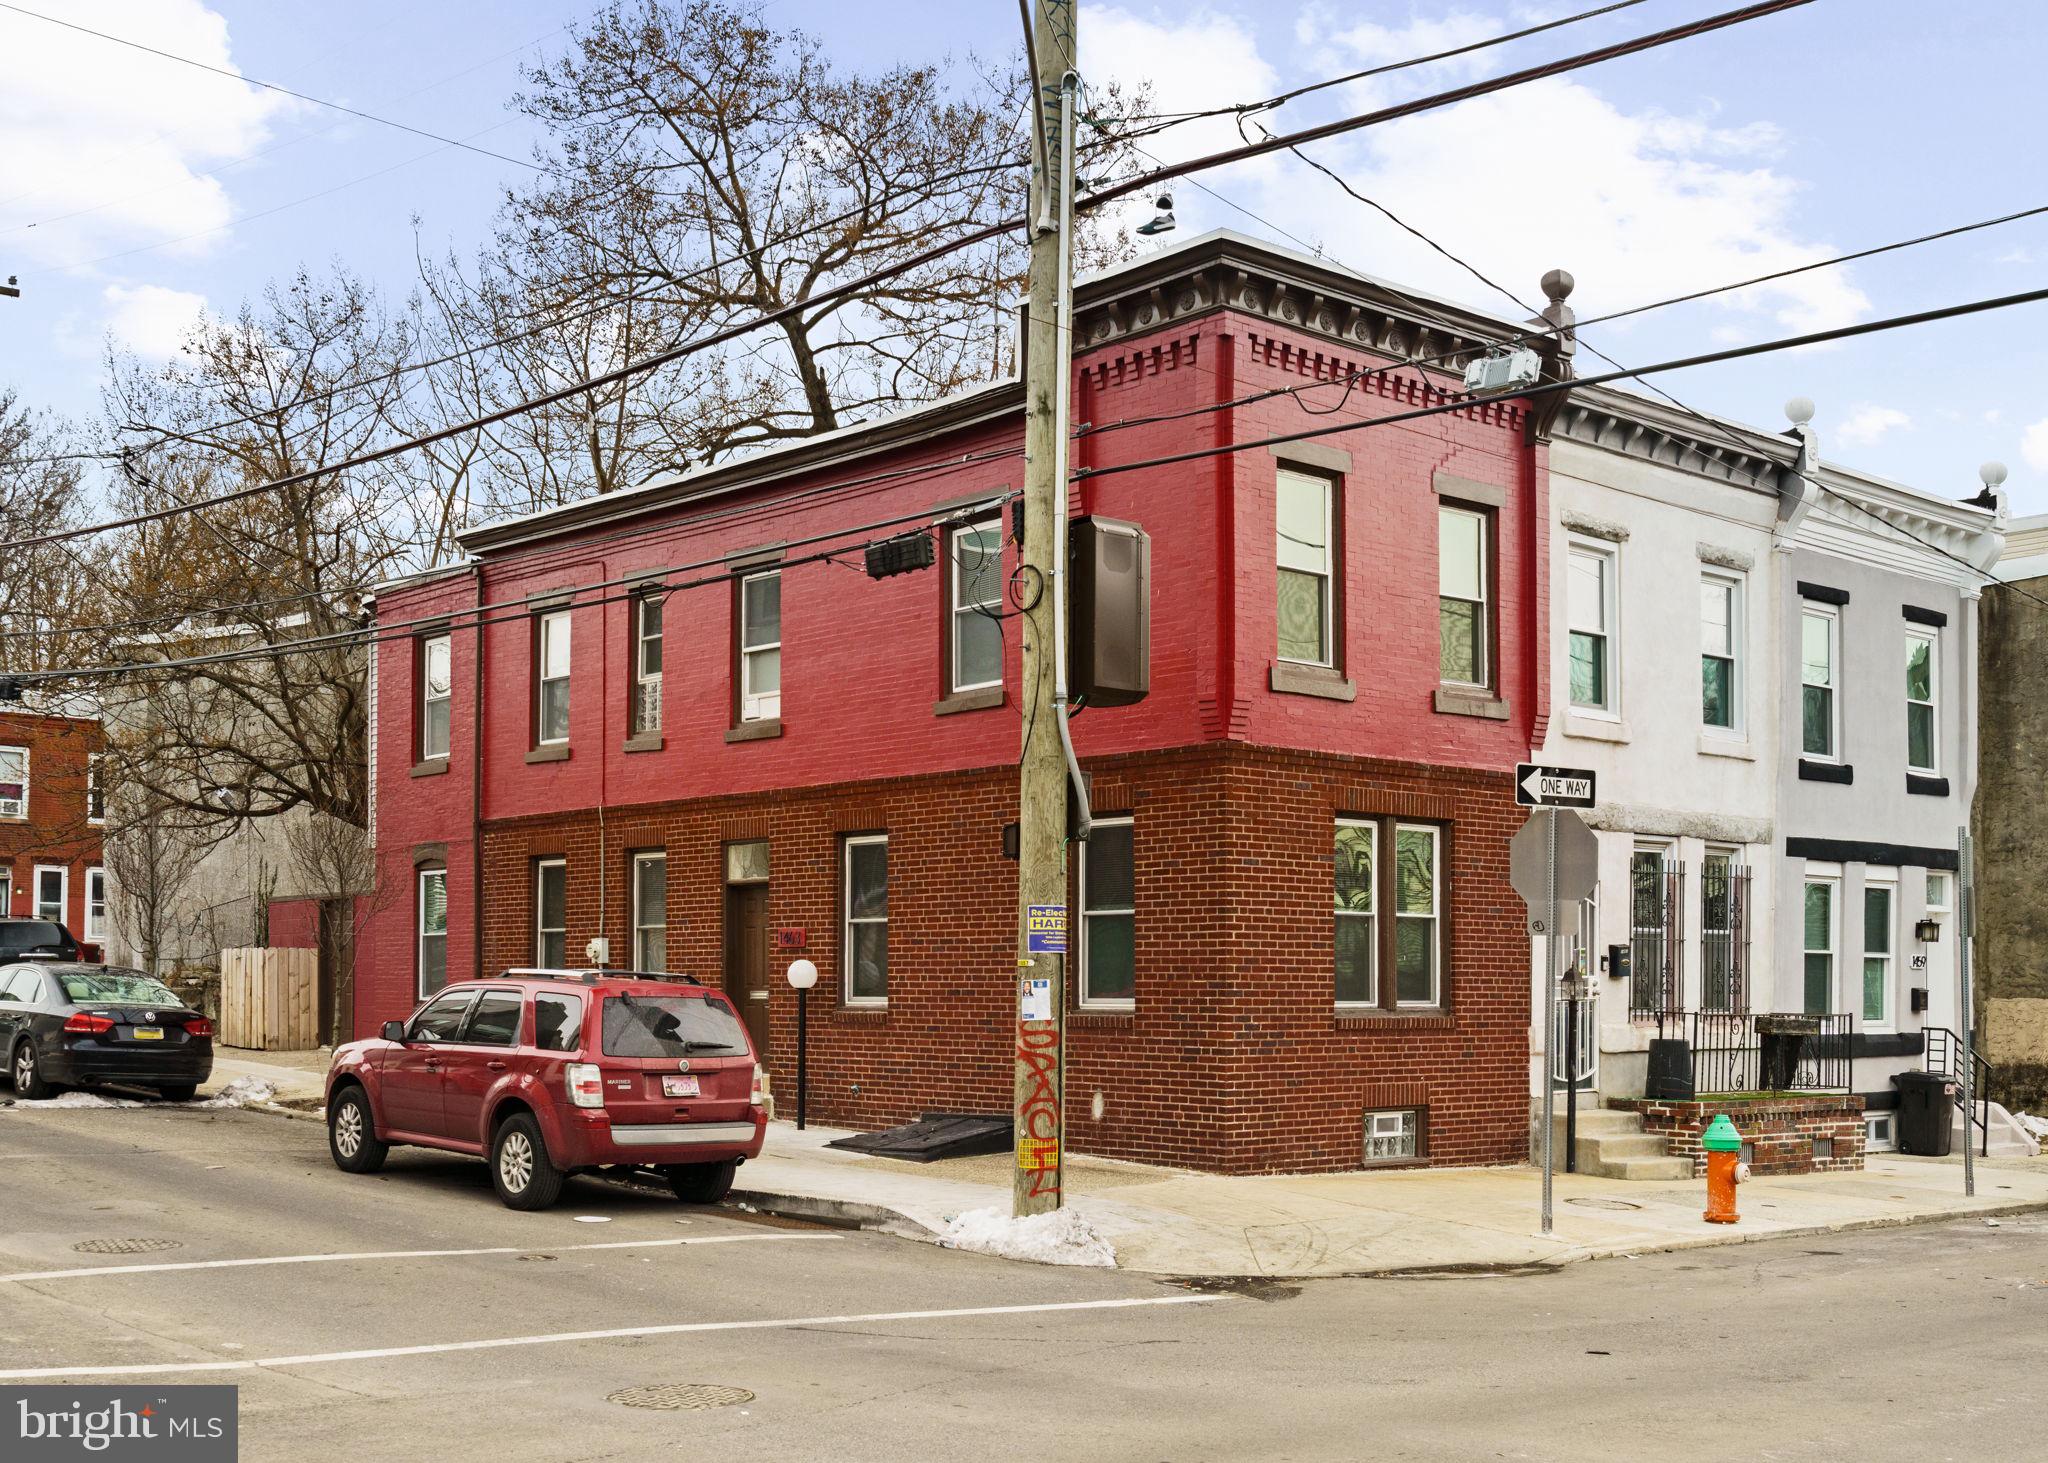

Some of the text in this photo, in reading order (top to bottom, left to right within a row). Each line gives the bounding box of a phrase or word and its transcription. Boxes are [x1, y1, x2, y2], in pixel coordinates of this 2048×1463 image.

[1541, 778, 1588, 796] ONE WAY
[1912, 955, 1926, 968] 1459
